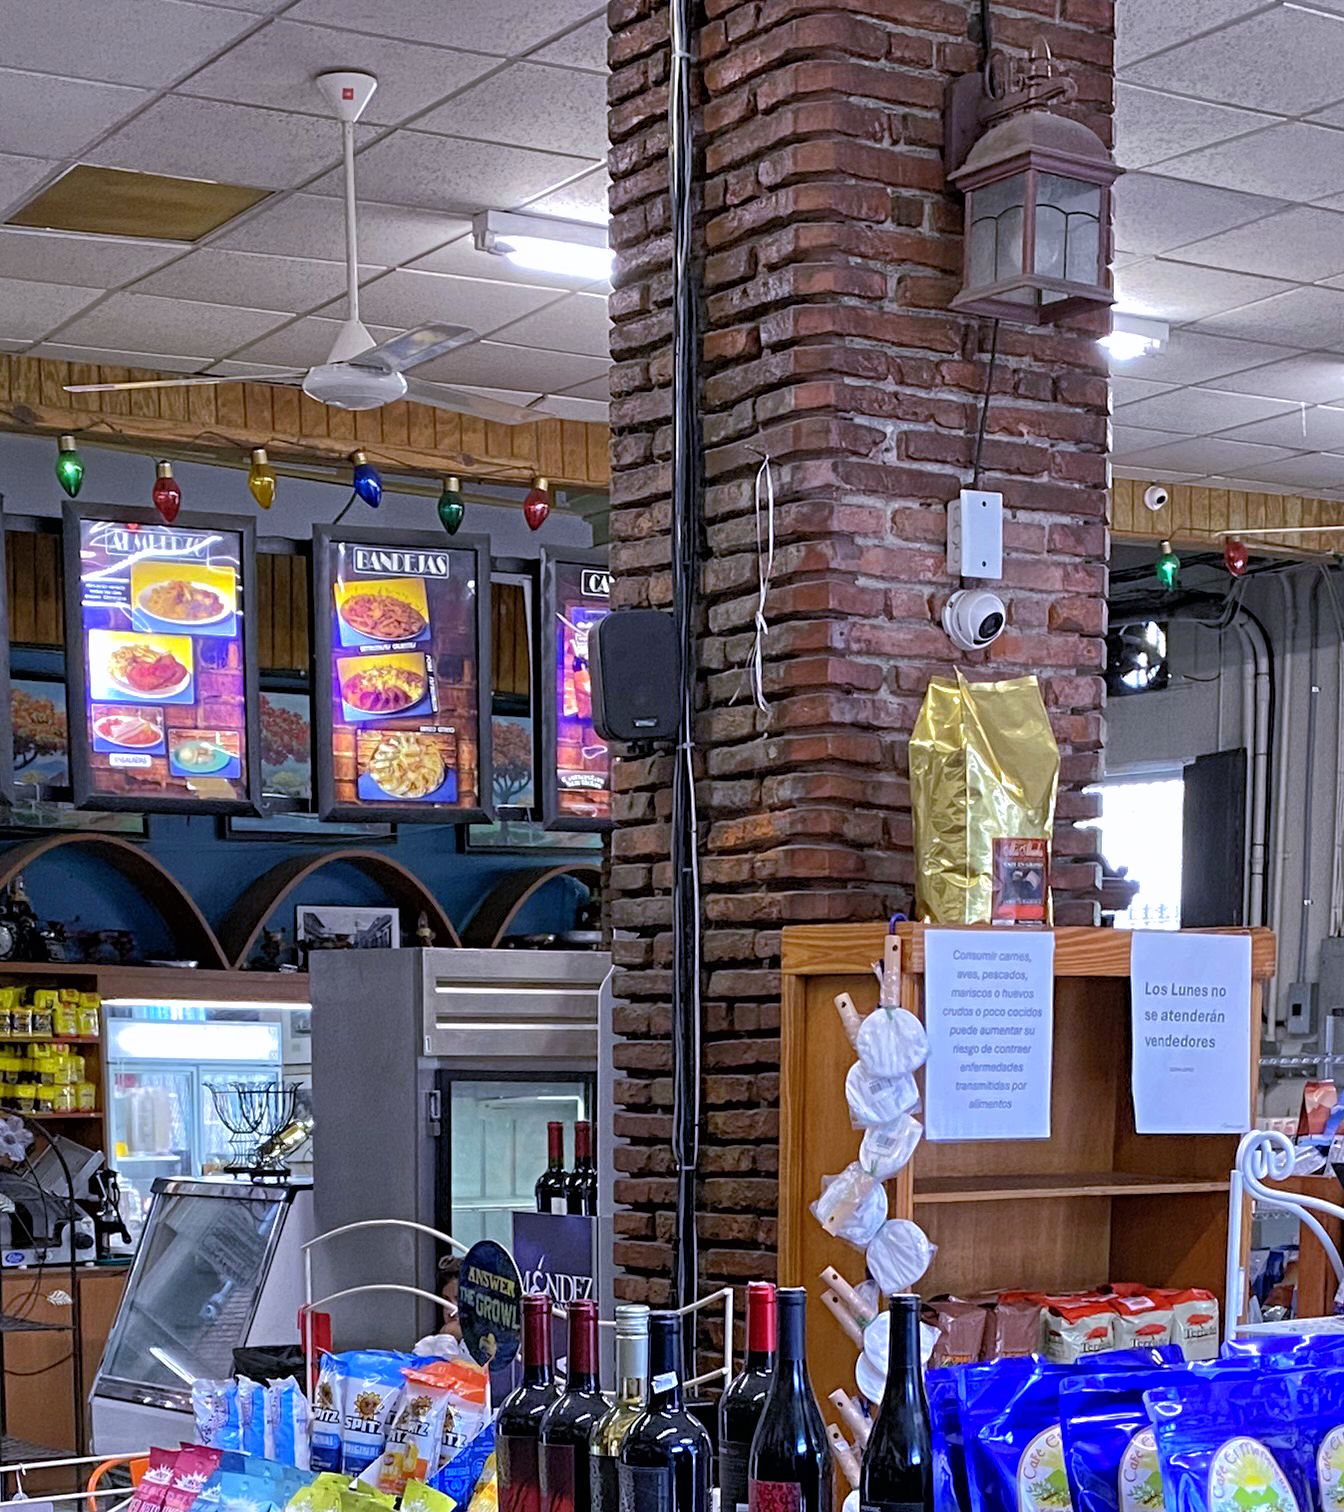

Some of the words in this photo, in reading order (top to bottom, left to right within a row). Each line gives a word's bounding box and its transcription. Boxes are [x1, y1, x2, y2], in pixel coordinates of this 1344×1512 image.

[357, 551, 447, 575] BANDEJAS
[953, 950, 997, 961] Consumir
[999, 953, 1032, 962] carnes,
[982, 971, 1028, 981] pescados,
[951, 988, 992, 999] mariscos
[1002, 989, 1034, 999] huevos
[1145, 982, 1167, 995] Los
[1171, 983, 1208, 997] Lunes
[1212, 986, 1226, 997] no
[942, 1007, 973, 1016] crudos
[983, 1008, 1005, 1018] poco
[1007, 1007, 1042, 1017] cocidos
[1144, 1011, 1158, 1021] se
[1161, 1009, 1225, 1023] atenderán
[949, 1025, 978, 1037] puede
[980, 1027, 1022, 1035] aumentar
[1024, 1027, 1035, 1035] su
[1145, 1034, 1216, 1048] vendedores
[953, 1045, 979, 1056] riesgo
[981, 1044, 992, 1054] de
[994, 1045, 1031, 1054] contraer
[960, 1062, 1024, 1072] enfermedades
[956, 1081, 1010, 1090] transmitidas
[1012, 1082, 1027, 1092] por
[969, 1099, 1012, 1109] alimentos
[468, 1266, 515, 1298] ANSWER
[476, 1294, 521, 1329] GROWL
[344, 1417, 382, 1434] SPITZ
